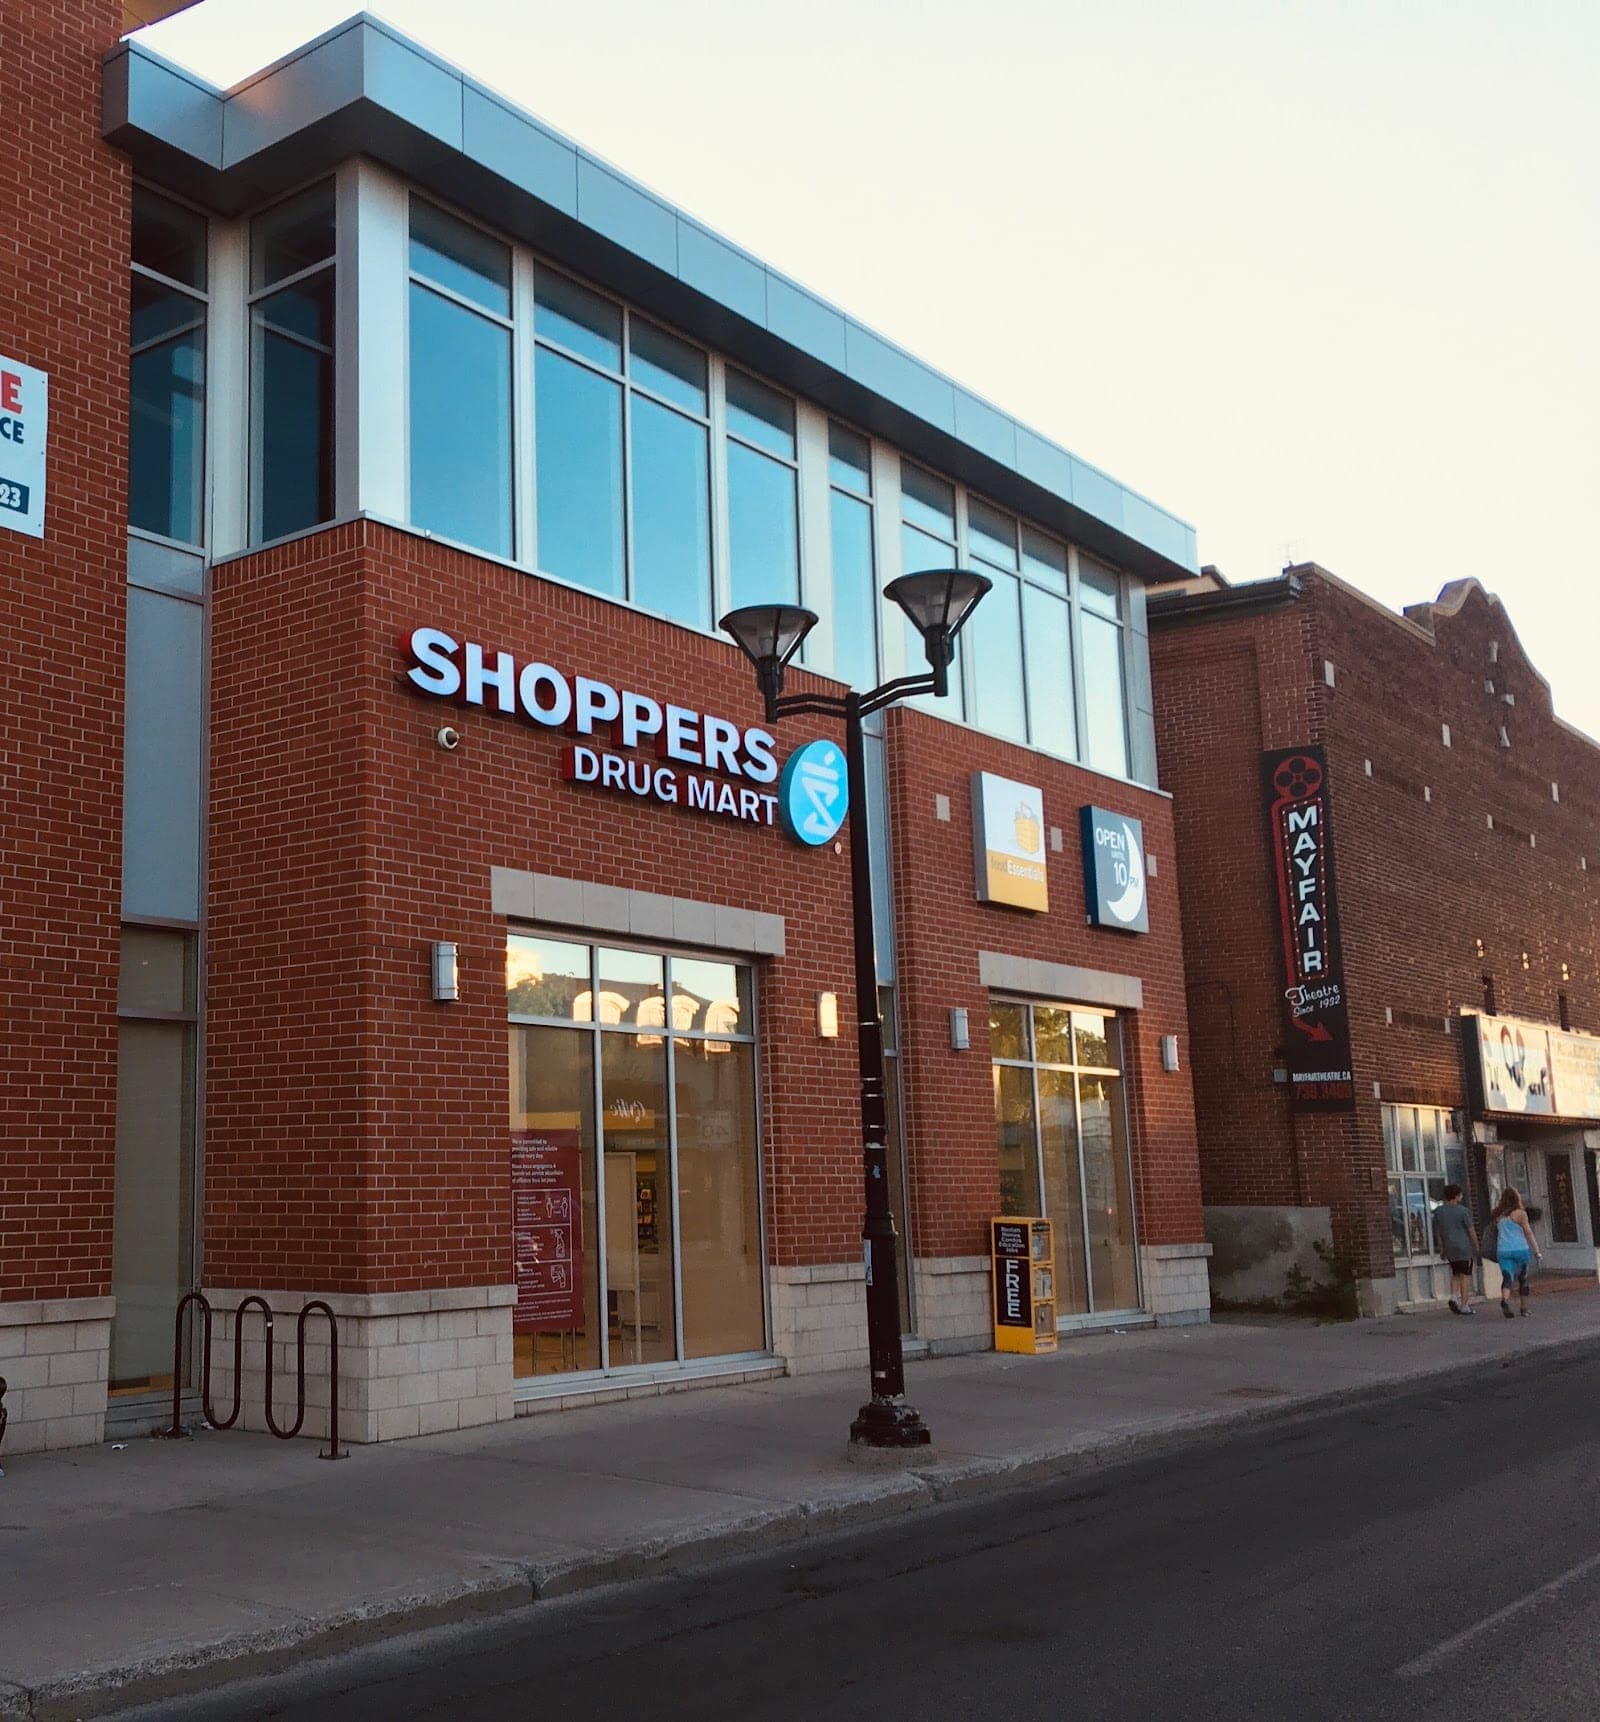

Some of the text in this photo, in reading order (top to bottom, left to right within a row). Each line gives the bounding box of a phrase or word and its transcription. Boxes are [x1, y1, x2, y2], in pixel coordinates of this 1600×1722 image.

[406, 626, 779, 784] SHOPPERS
[573, 746, 779, 826] DRUG MART
[1095, 827, 1125, 851] OPEN
[1113, 861, 1128, 887] 10
[1288, 804, 1323, 974] MAYFAIR
[1284, 984, 1340, 1006] Theatre
[1006, 1259, 1021, 1318] FREE
